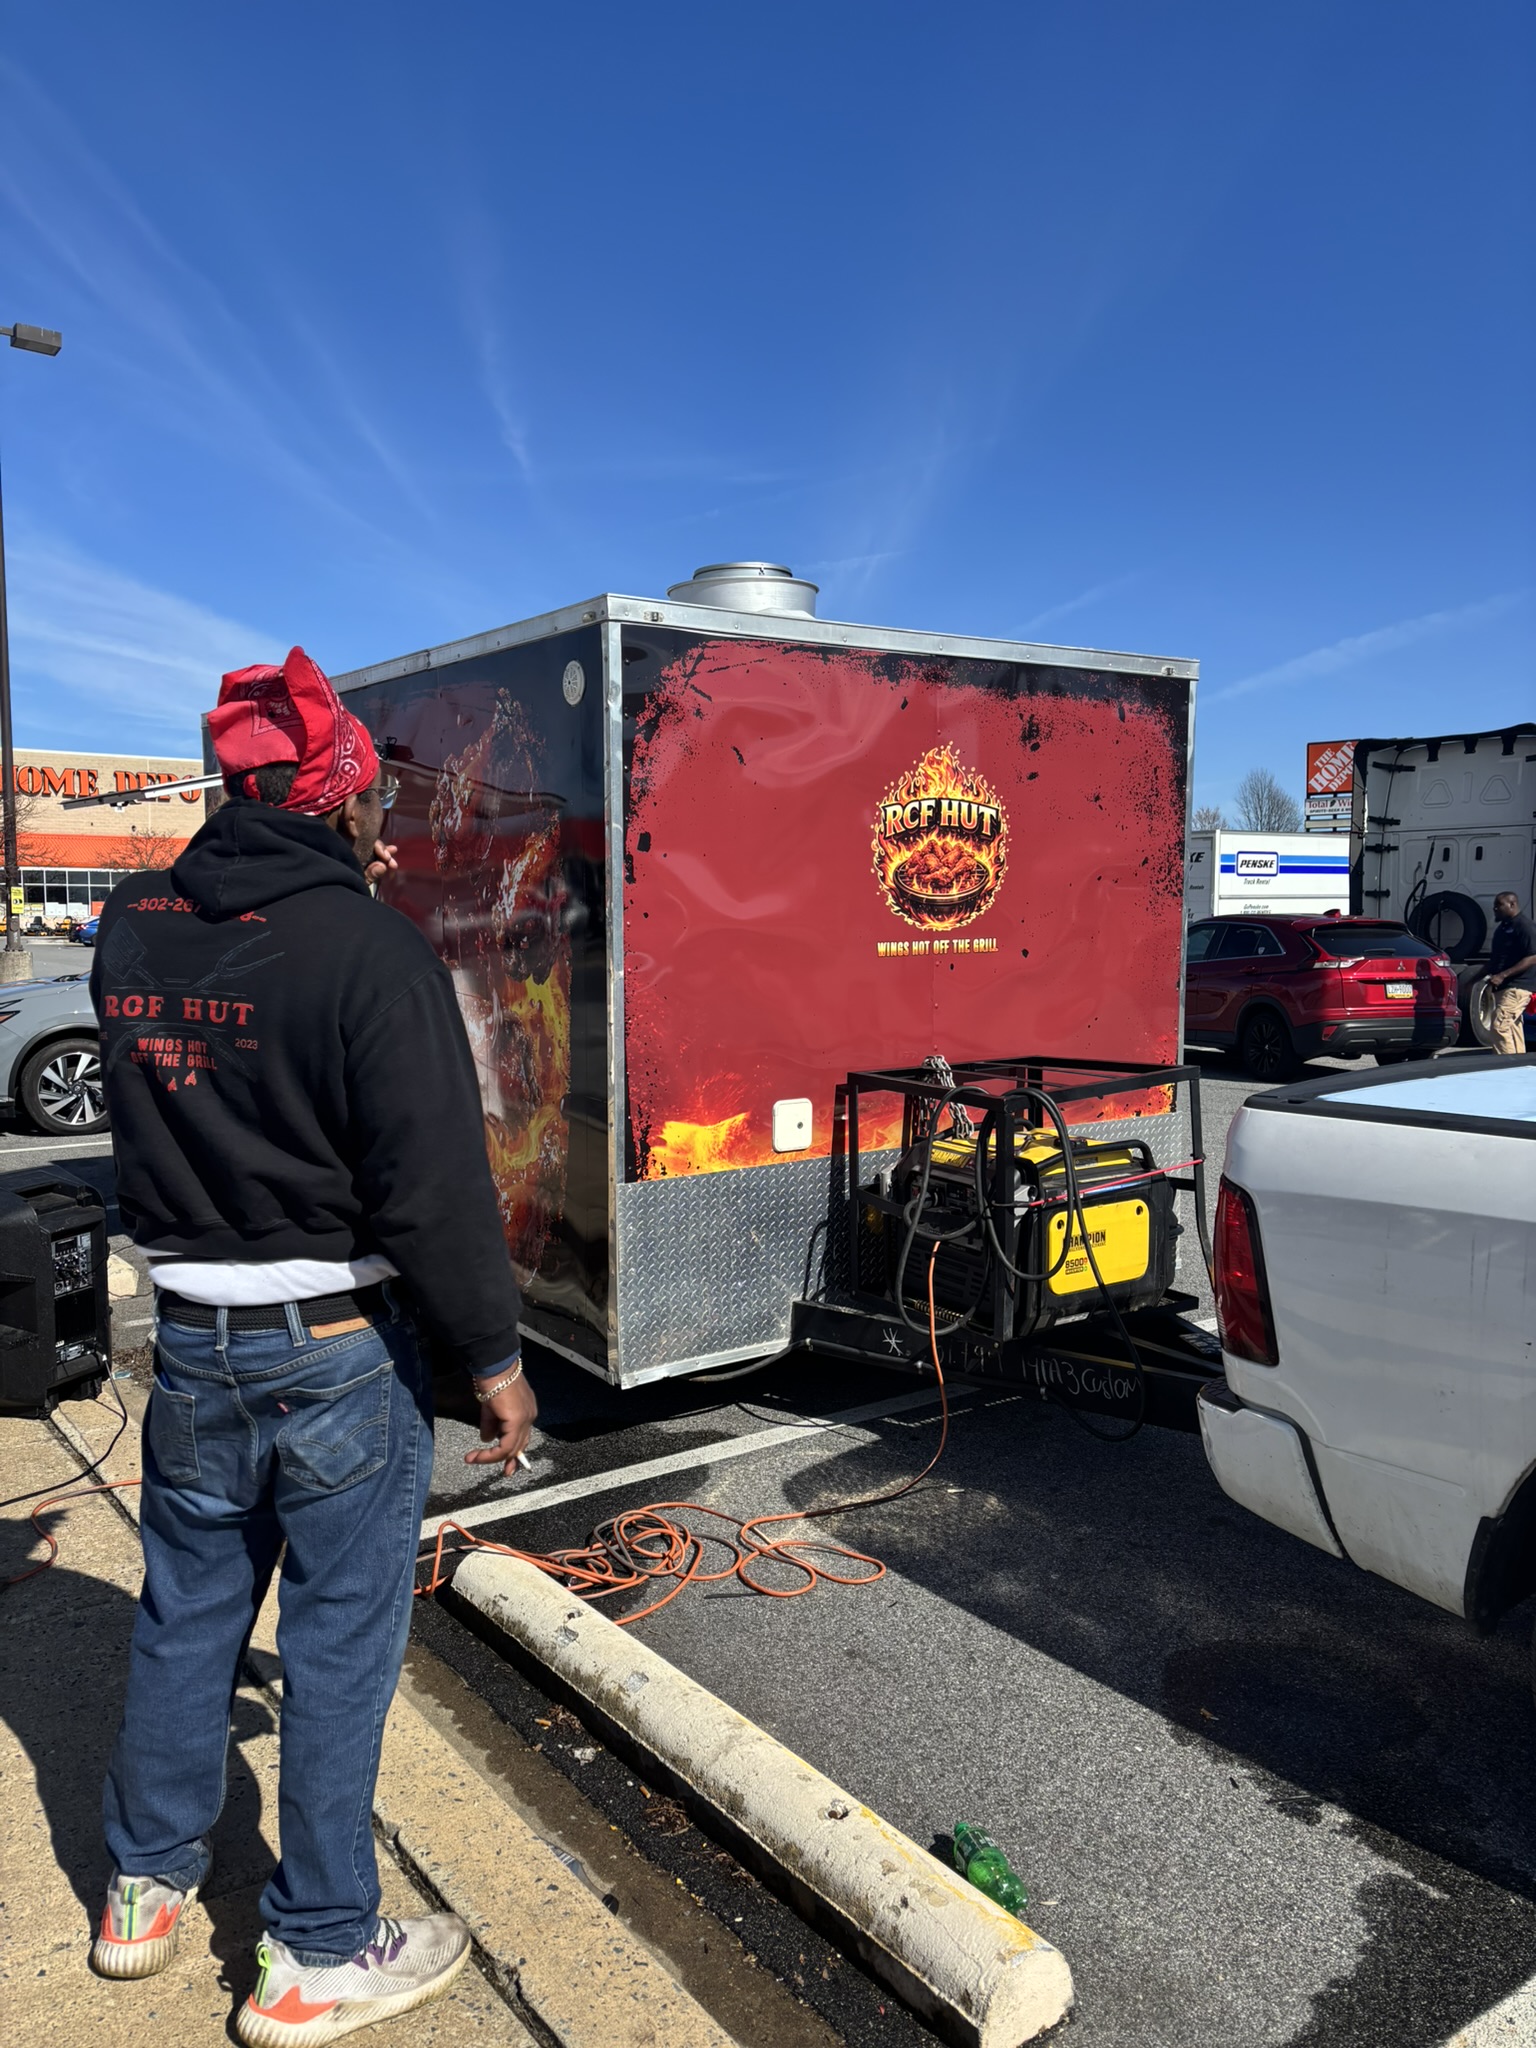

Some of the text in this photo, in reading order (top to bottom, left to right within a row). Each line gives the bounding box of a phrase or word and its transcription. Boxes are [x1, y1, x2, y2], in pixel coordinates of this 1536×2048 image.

[1314, 748, 1335, 768] THE
[1328, 761, 1354, 792] DEPO
[114, 770, 202, 802] DEPO
[1308, 798, 1352, 809] Total Wi
[885, 800, 997, 837] RCF HUT
[1240, 859, 1275, 868] PENSKE
[877, 938, 999, 957] WINGS HOT OFF THE GRILL
[104, 995, 254, 1026] RCF HUT
[137, 1037, 207, 1054] WINGS HOT
[234, 1038, 258, 1050] 2023
[130, 1052, 218, 1070] OFF THE GRILL
[1065, 1257, 1084, 1268] 8500
